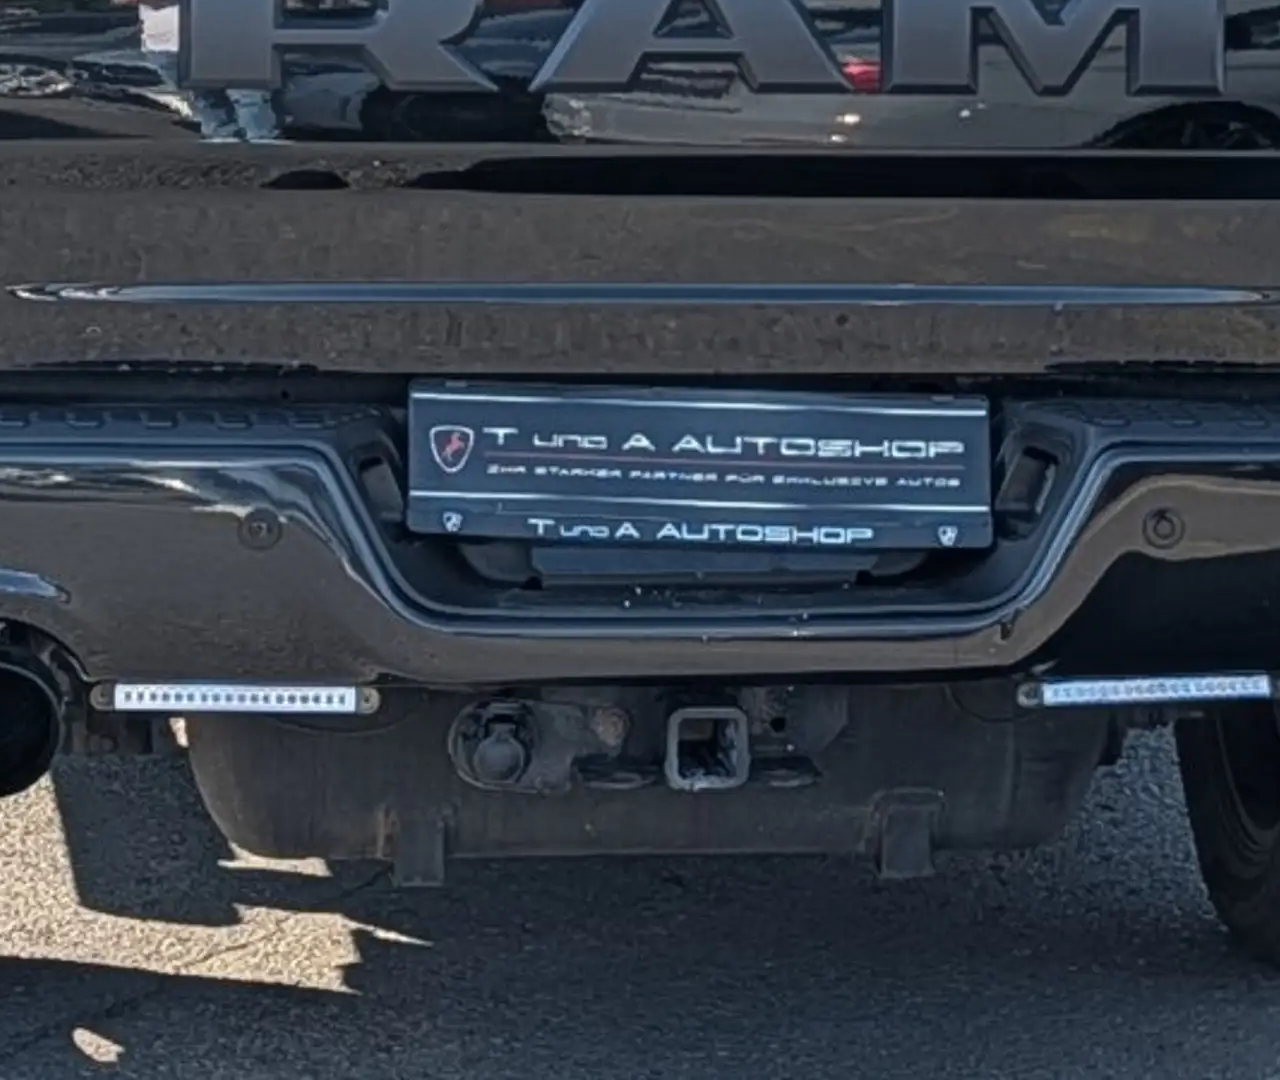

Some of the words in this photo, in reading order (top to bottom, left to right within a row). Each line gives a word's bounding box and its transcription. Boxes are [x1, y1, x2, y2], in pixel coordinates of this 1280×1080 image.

[482, 426, 519, 445] T
[622, 432, 656, 452] A
[672, 434, 965, 458] AUTOSHOP
[656, 522, 874, 545] AUTOSHOP
